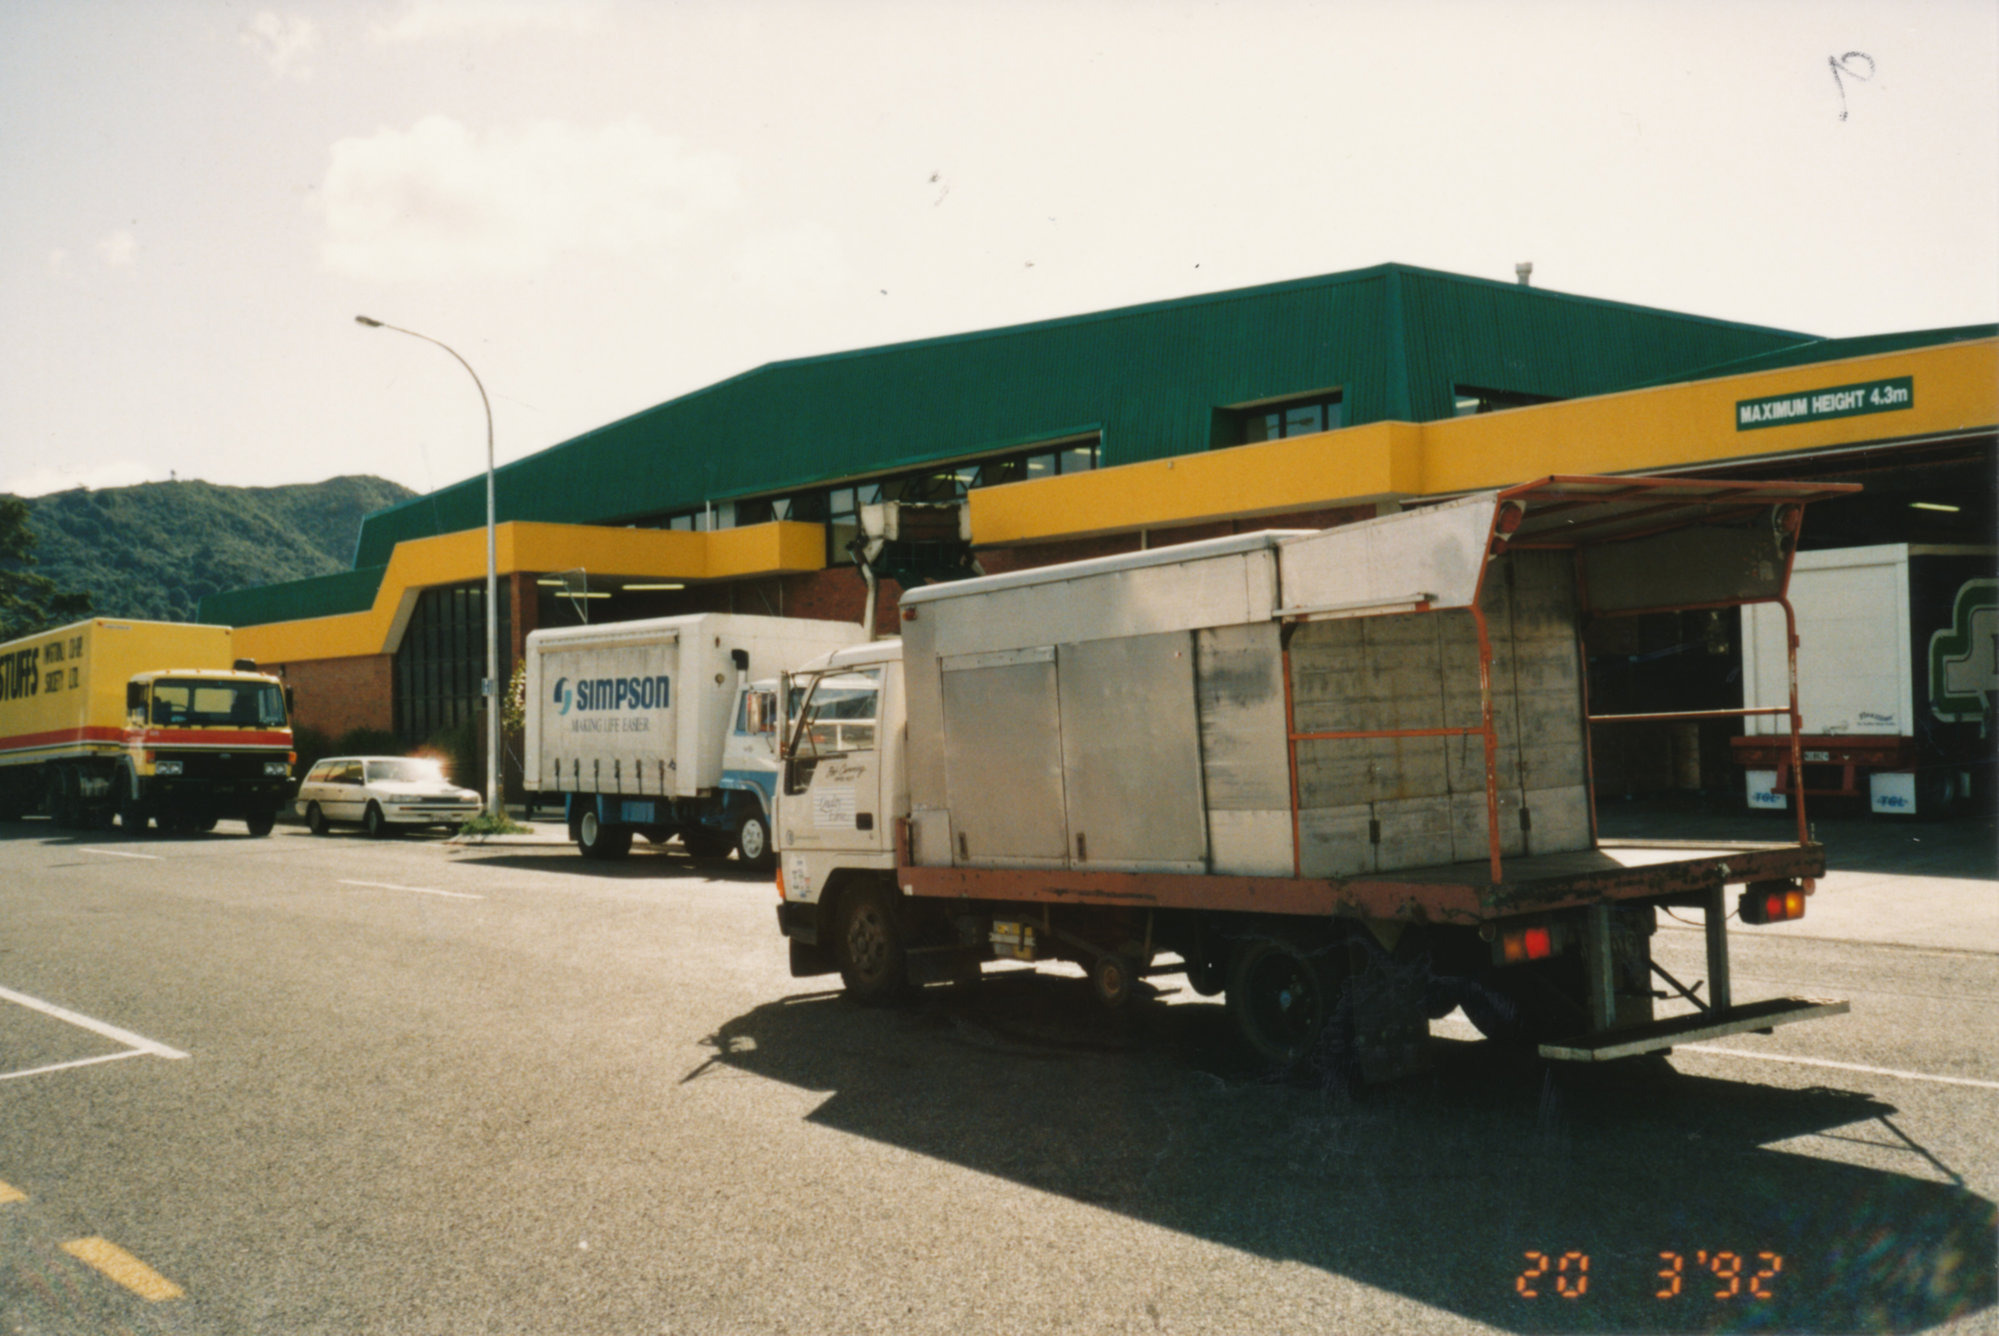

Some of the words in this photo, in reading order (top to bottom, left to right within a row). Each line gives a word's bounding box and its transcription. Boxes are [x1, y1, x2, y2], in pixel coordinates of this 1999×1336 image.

[1740, 398, 1808, 424] MAXIMUM
[1812, 389, 1865, 414] HEIGHT
[1870, 385, 1908, 406] 4.3m
[576, 675, 670, 711] SIMPSON
[572, 718, 602, 733] MAKING
[604, 718, 620, 732] LIFE
[622, 717, 650, 732] EASIER
